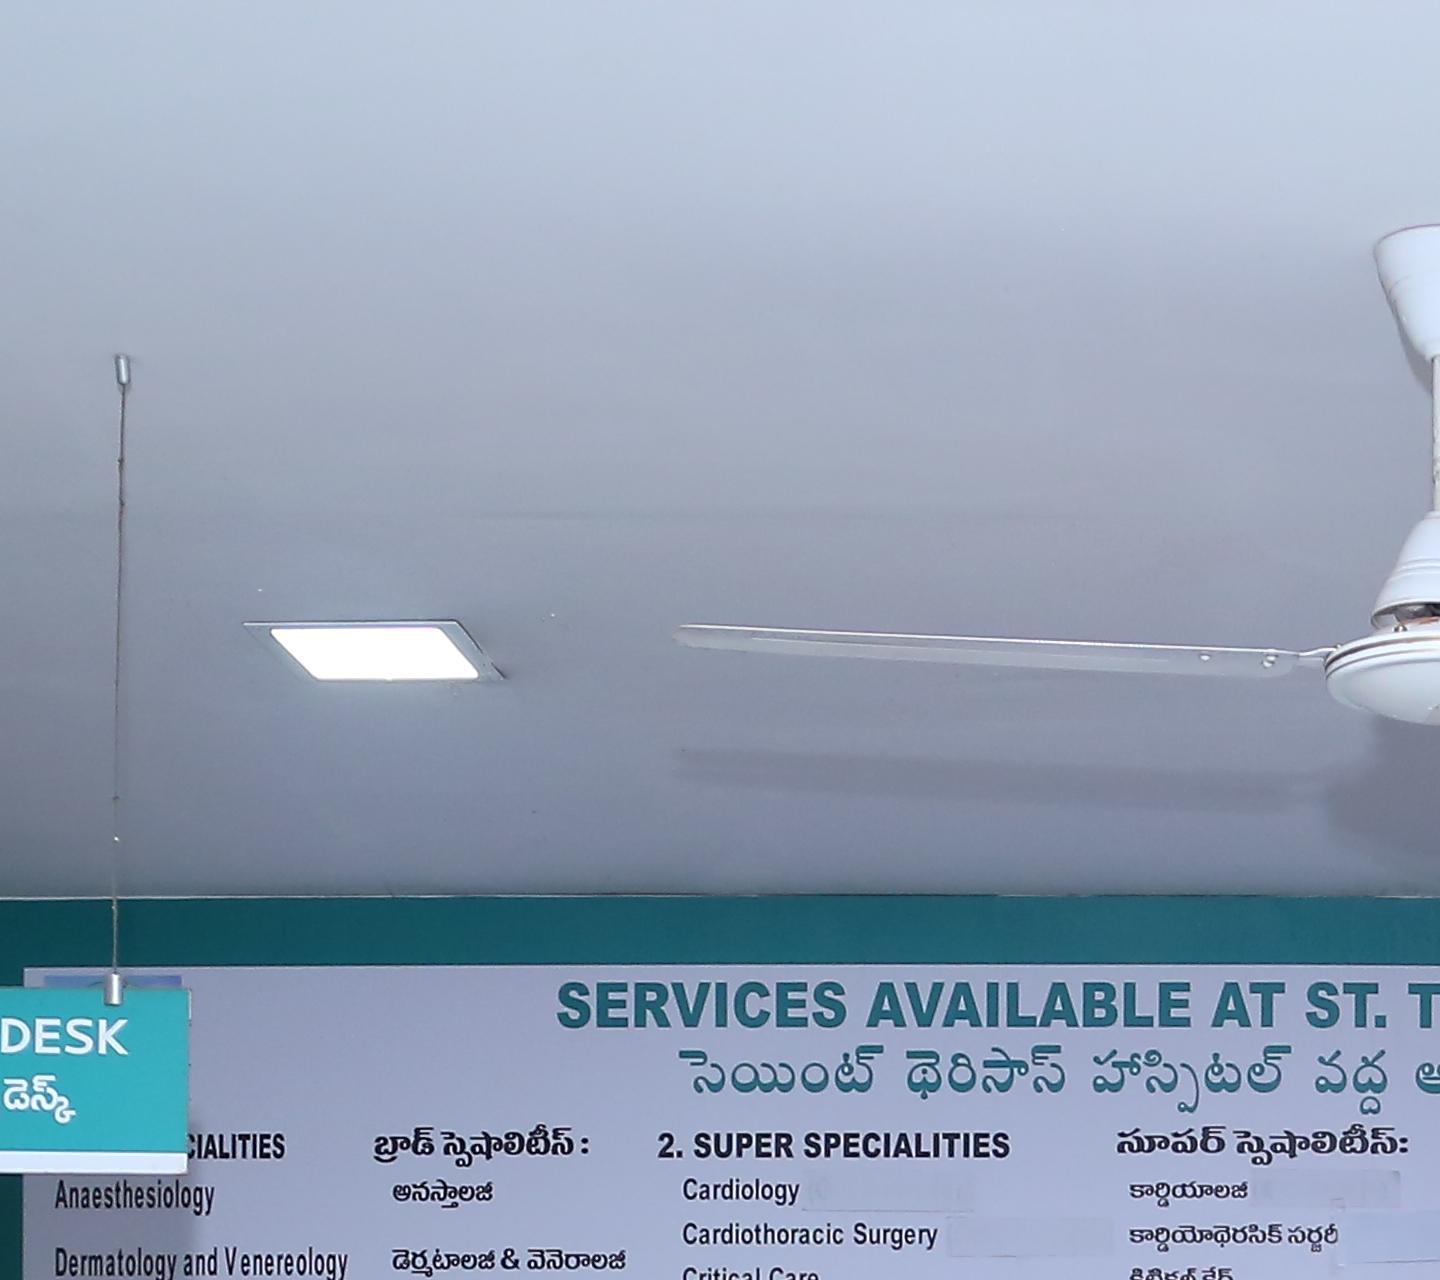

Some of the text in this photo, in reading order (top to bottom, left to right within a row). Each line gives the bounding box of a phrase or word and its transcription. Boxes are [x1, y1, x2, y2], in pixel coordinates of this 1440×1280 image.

[557, 981, 847, 1029] SERVICES
[866, 982, 1191, 1029] AVAILABLE
[1211, 982, 1285, 1027] AT
[1305, 982, 1386, 1028] ST.
[1, 1018, 128, 1055] DESK
[658, 1132, 1010, 1158] 2. SUPER SPECIALITIES
[55, 1179, 217, 1216] Anaesthesiology
[683, 1178, 799, 1206] Cardiology
[683, 1223, 938, 1250] Cardiothoracic Surgery
[183, 1247, 220, 1278] and
